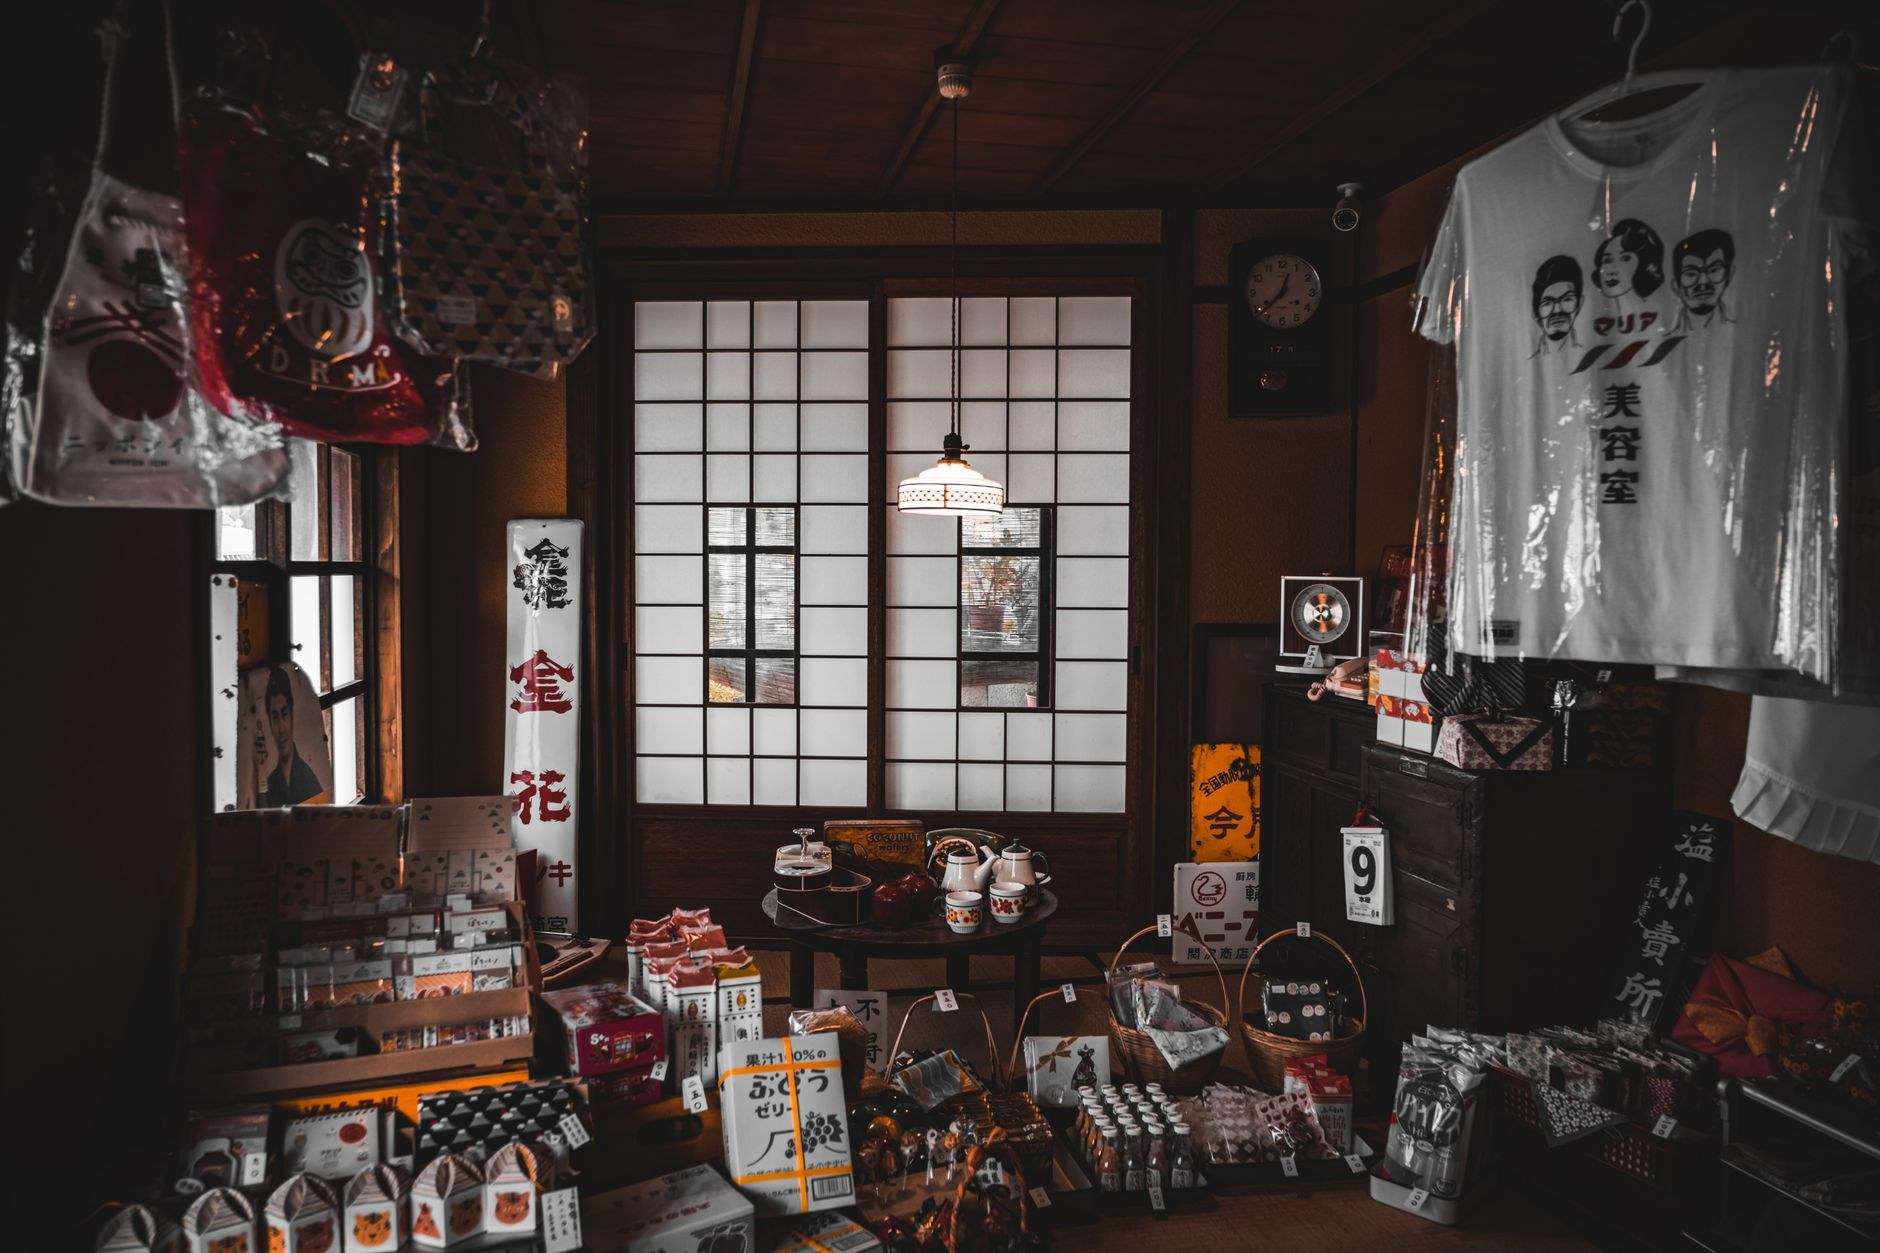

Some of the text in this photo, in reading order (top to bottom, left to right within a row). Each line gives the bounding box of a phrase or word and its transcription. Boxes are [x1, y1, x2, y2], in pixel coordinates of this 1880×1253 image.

[1593, 312, 1657, 336] マリア
[1601, 382, 1641, 504] 美容室
[1351, 845, 1377, 896] 9
[745, 1049, 828, 1068] 果汁10%の
[748, 1068, 830, 1100] ぶどう
